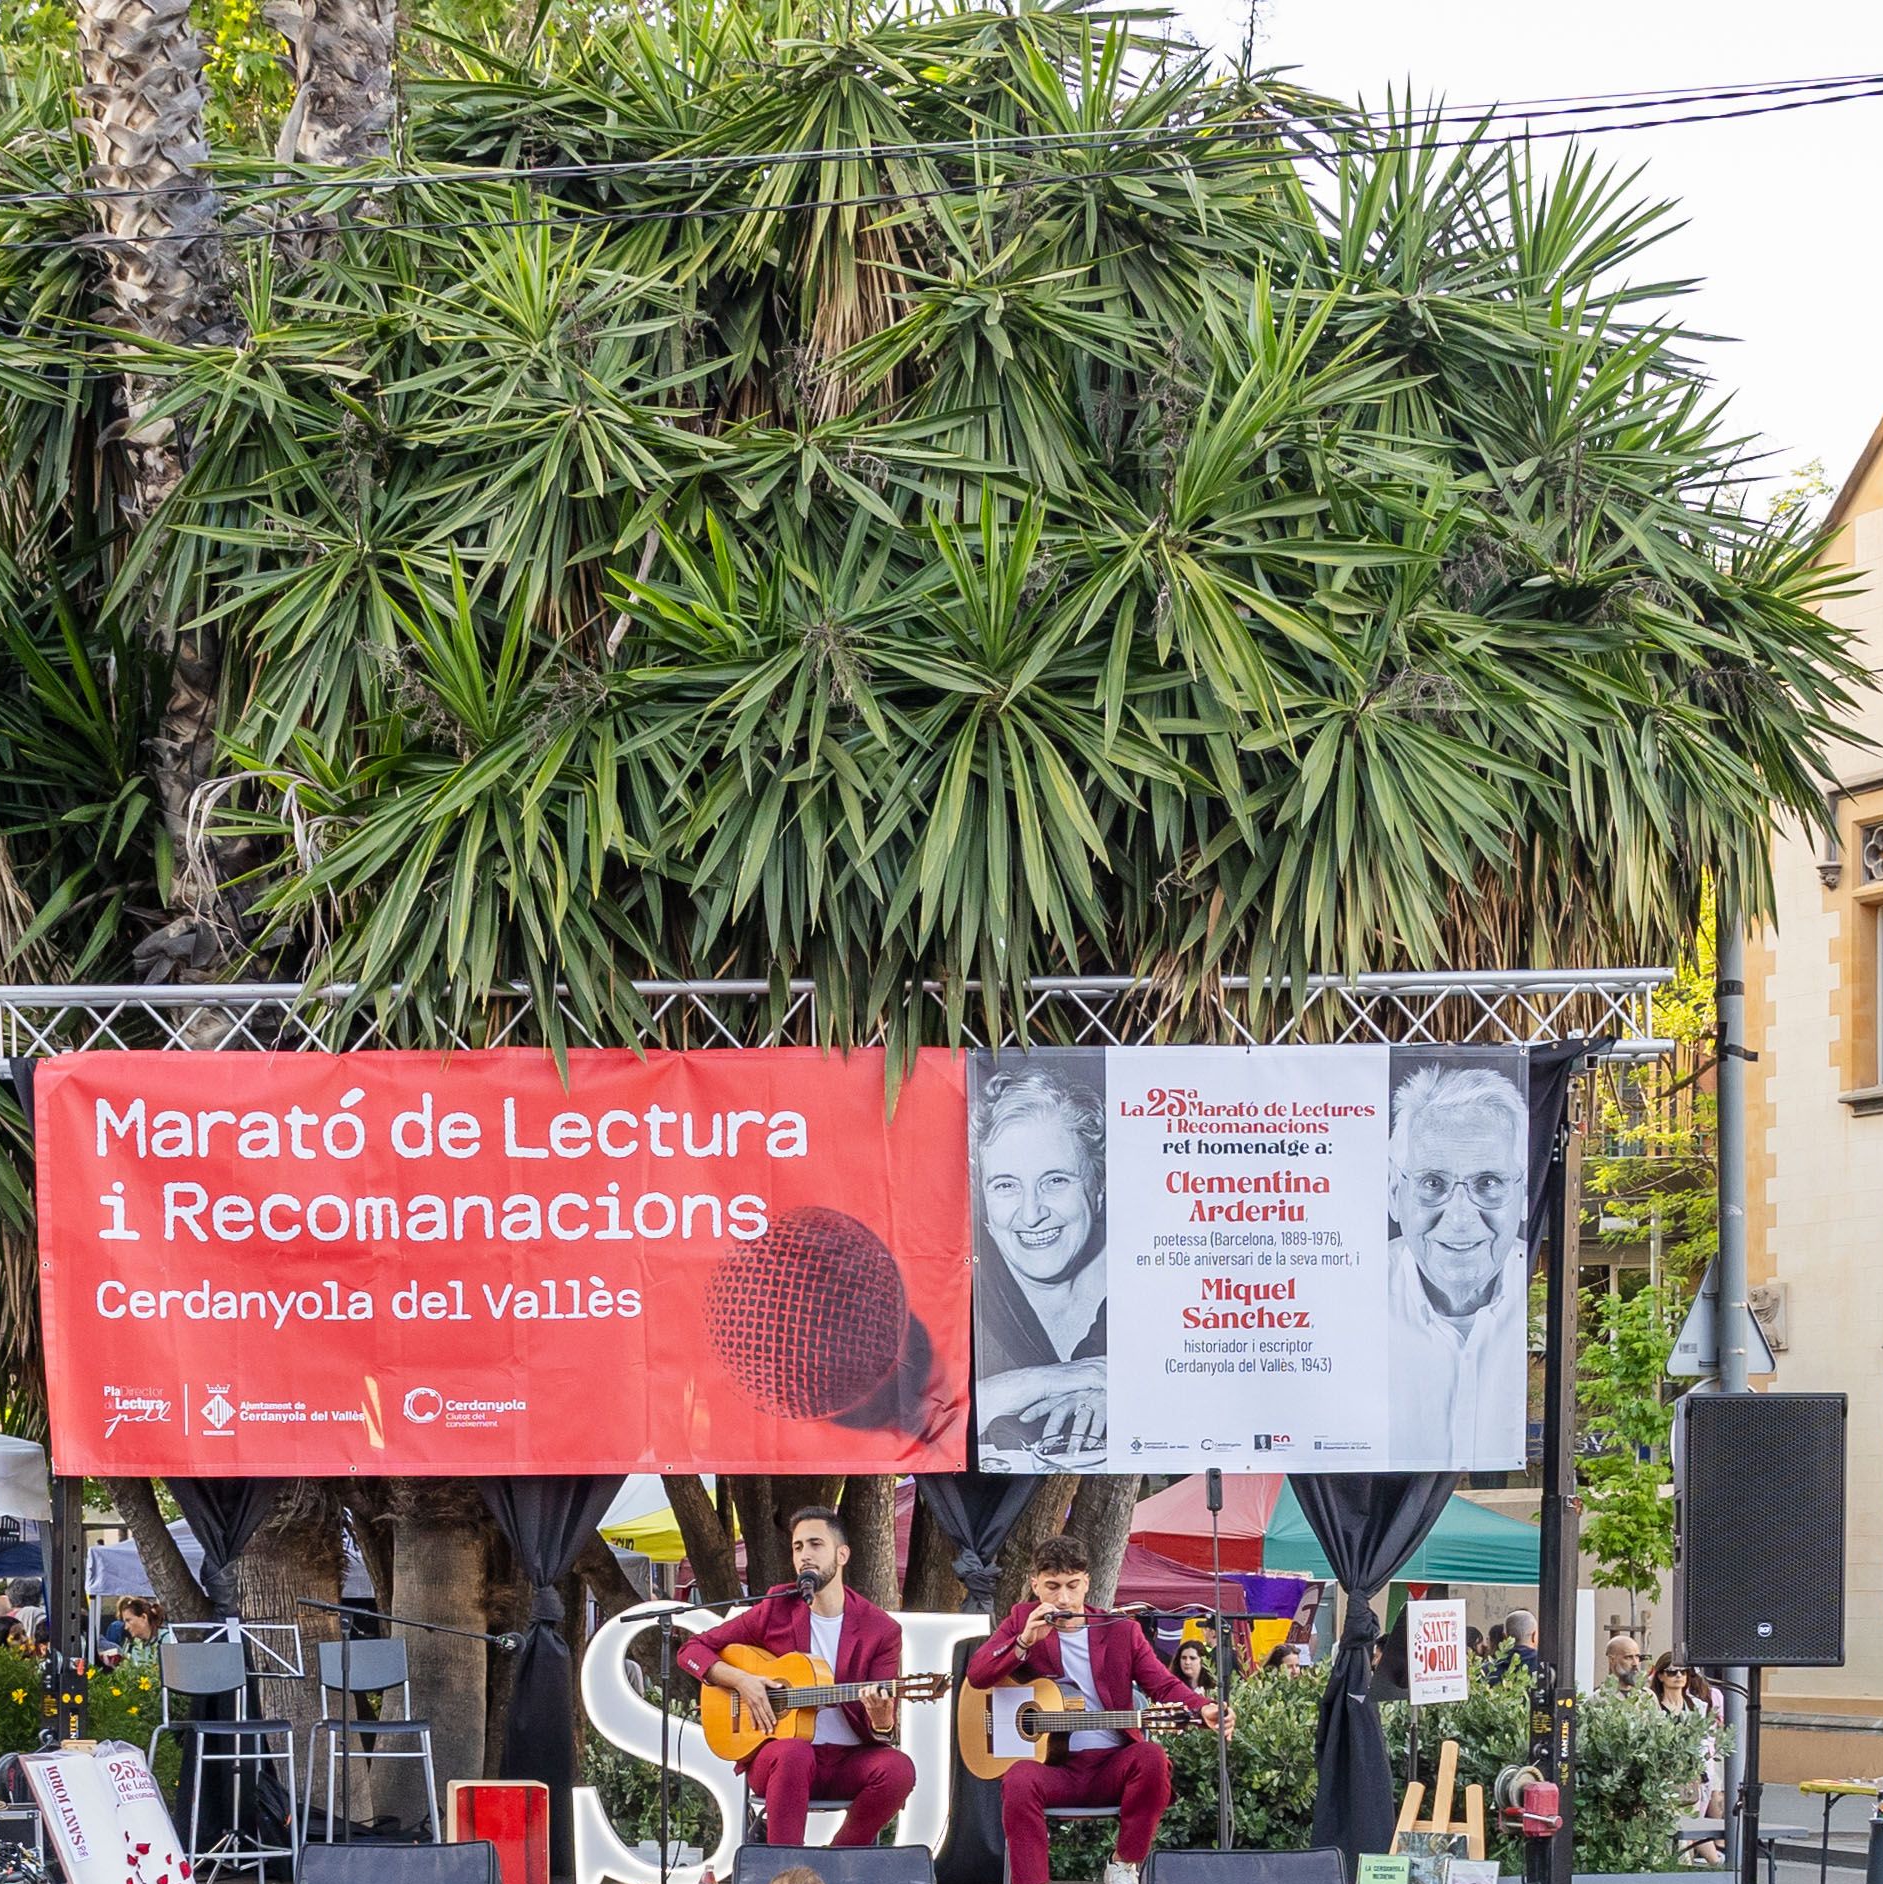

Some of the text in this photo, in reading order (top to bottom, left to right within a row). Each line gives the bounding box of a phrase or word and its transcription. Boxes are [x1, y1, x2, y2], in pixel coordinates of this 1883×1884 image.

[1120, 1102, 1144, 1117] La
[1189, 1100, 1258, 1117] Marató
[1264, 1101, 1287, 1117] de
[1292, 1101, 1375, 1117] Lectures
[95, 1087, 808, 1159] Marató de Lectura
[1166, 1119, 1329, 1134] i Recomanacions
[1162, 1139, 1333, 1157] ret homenatge a:
[1166, 1170, 1330, 1194] Clementina
[98, 1181, 769, 1241] i Recomanacions
[1153, 1233, 1207, 1248] poetessa
[1210, 1231, 1277, 1248] (Barcelona,
[1137, 1255, 1151, 1266] en
[1154, 1253, 1165, 1266] el
[1194, 1252, 1253, 1266] aniversari
[1257, 1252, 1272, 1266] de
[1276, 1252, 1286, 1265] la
[1290, 1255, 1317, 1265] seva
[1321, 1253, 1352, 1267] mort,
[1201, 1277, 1296, 1305] Miquel
[96, 1275, 642, 1330] Cerdanyola del Vallès
[1184, 1339, 1248, 1353] historiador
[1259, 1340, 1313, 1355] escriptor
[1165, 1357, 1332, 1375] (Cerdanyola del Vallès, 1943)
[240, 1401, 306, 1411] Ajuntament de
[445, 1399, 527, 1412] Cerdanyola
[239, 1410, 366, 1423] Cerdanyola del Vallès
[445, 1413, 486, 1421] Ciutat del
[1423, 1621, 1450, 1643] SANT
[1423, 1644, 1458, 1674] JORDI
[46, 1765, 72, 1804] JORDI
[117, 1781, 132, 1793] de
[60, 1807, 85, 1846] SANT
